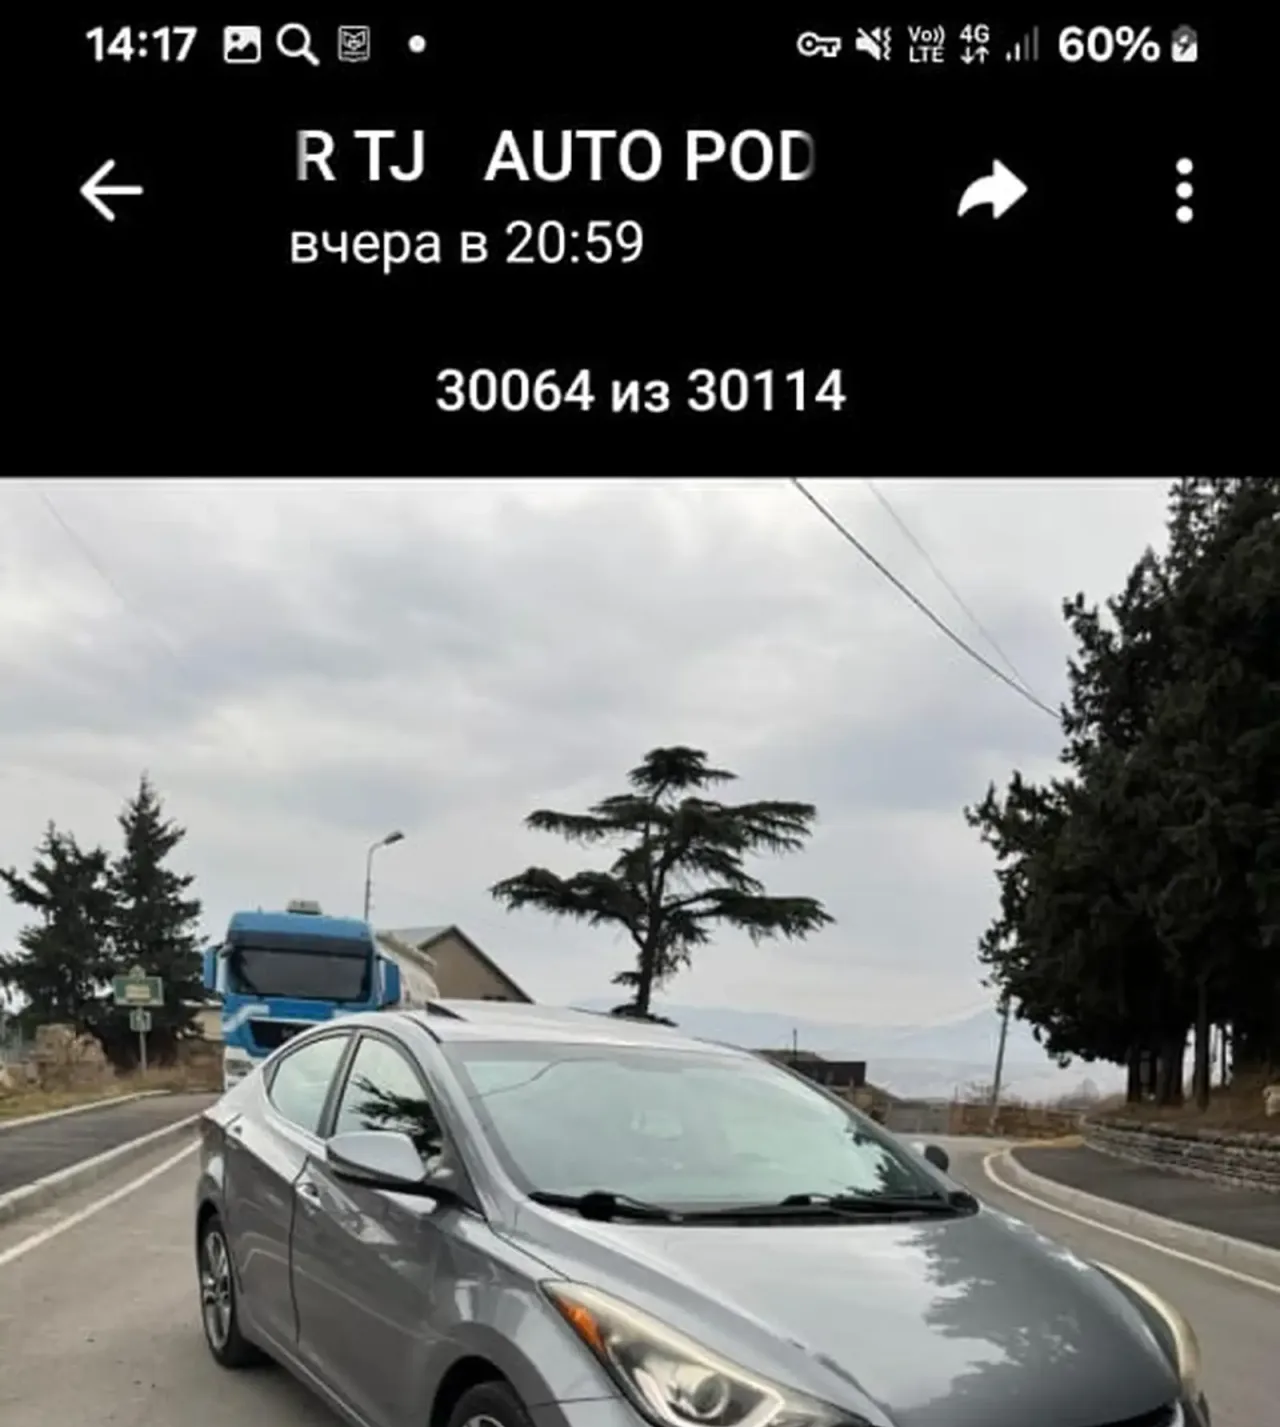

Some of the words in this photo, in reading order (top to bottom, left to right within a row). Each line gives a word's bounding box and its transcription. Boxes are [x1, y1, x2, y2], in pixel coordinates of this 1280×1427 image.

[85, 25, 198, 62] 14:17
[959, 23, 990, 44] 4G
[1058, 25, 1161, 63] 60%
[908, 45, 945, 64] LTE
[296, 129, 337, 182] R
[353, 129, 425, 183] TJ
[483, 128, 663, 183] AUTO
[686, 128, 814, 182] POD
[290, 230, 442, 275] вчера
[460, 230, 489, 264] в
[505, 219, 644, 265] 20:59
[436, 368, 596, 412] 30064
[611, 379, 671, 414] из
[687, 367, 847, 412] 30114
